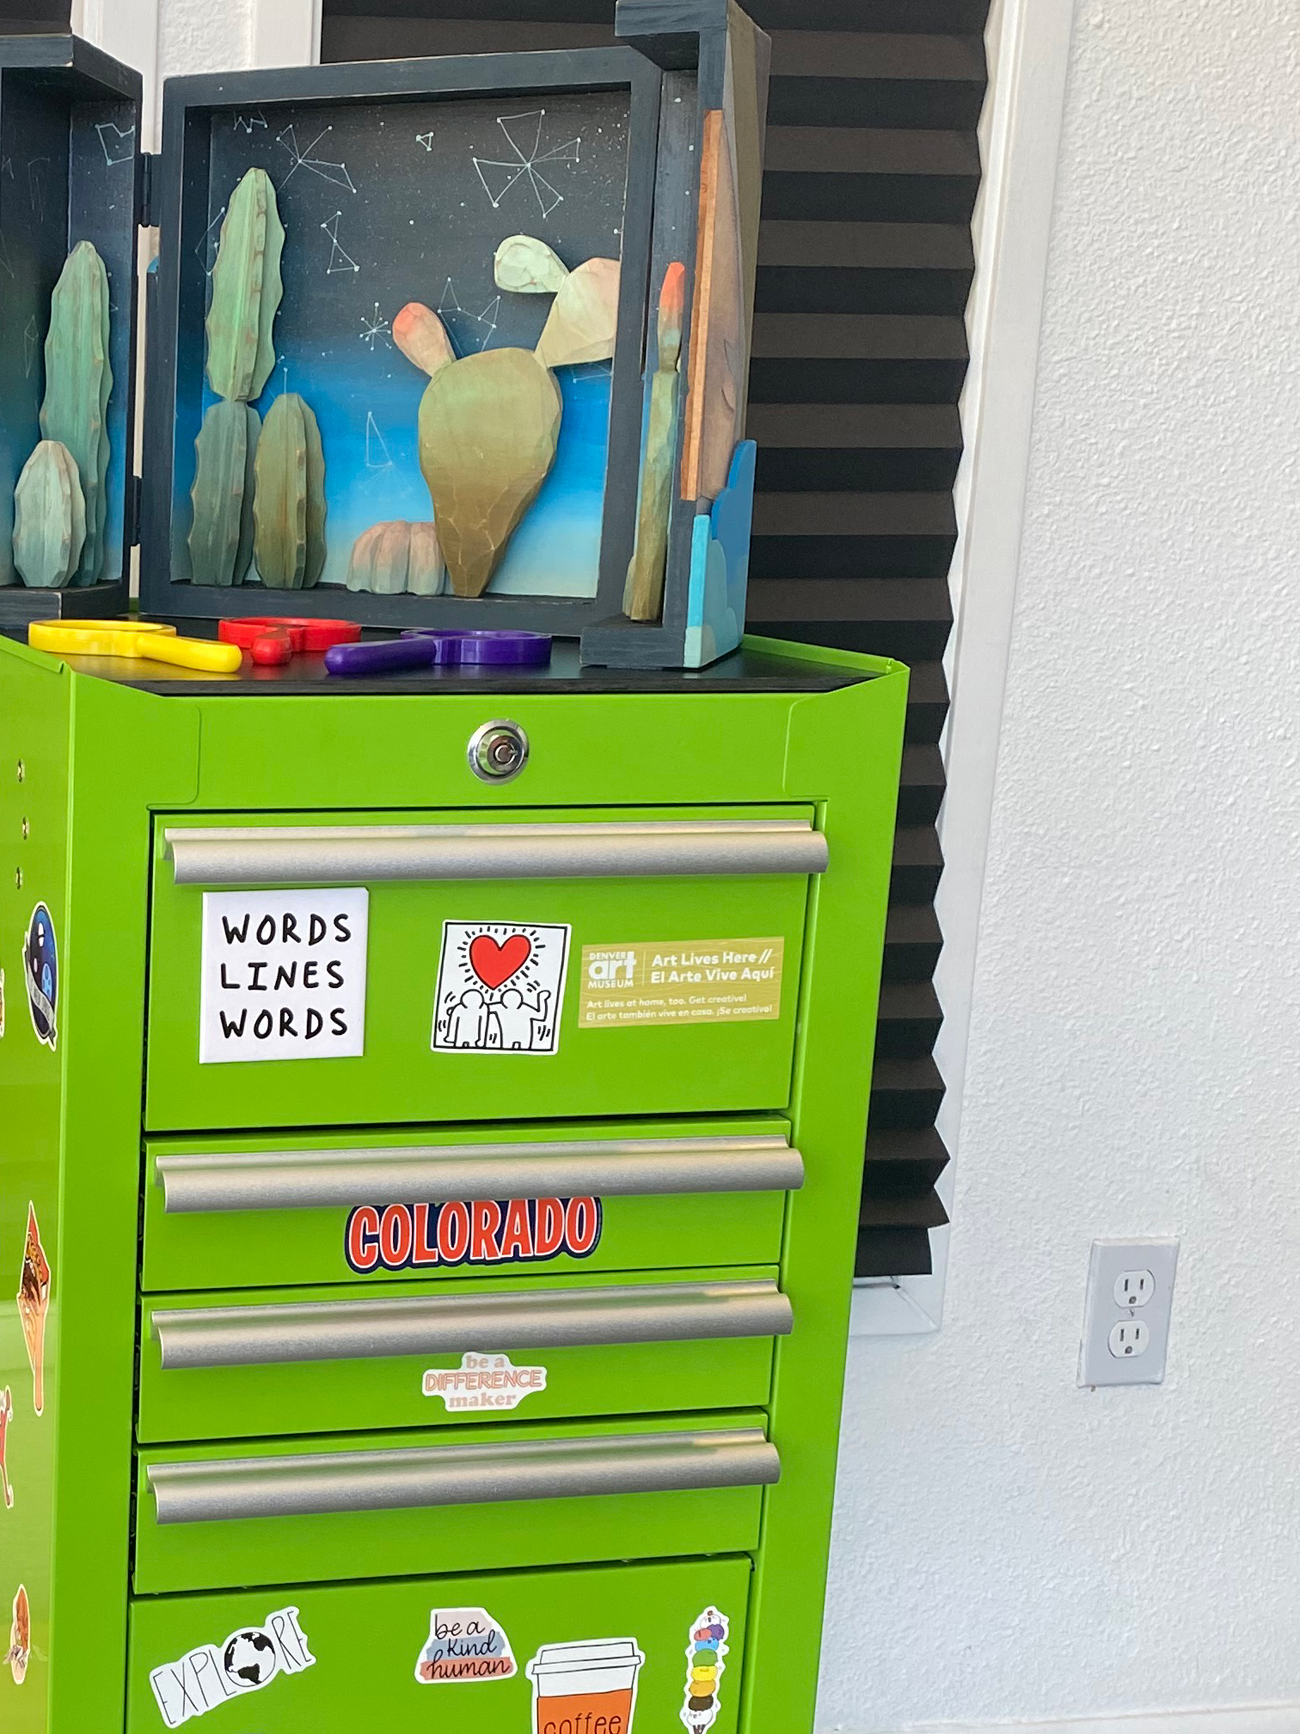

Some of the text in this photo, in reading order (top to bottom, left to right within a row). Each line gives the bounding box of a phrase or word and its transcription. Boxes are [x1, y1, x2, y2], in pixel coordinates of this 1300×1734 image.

[222, 912, 352, 946] WORDS
[588, 951, 637, 980] art
[589, 951, 628, 961] DENVER
[651, 955, 677, 967] Art
[681, 952, 719, 966] Lives
[722, 951, 757, 965] Here
[220, 960, 345, 991] LINES
[588, 979, 634, 989] MUSEUM
[651, 966, 775, 983] El Arte Vive Aquí
[586, 1000, 602, 1009] Art
[604, 999, 625, 1008] lives
[638, 998, 667, 1007] home,
[668, 996, 686, 1005] too.
[688, 995, 706, 1004] Get
[219, 1007, 348, 1041] WORDS
[586, 1012, 596, 1021] El
[597, 1012, 617, 1020] arte
[618, 1009, 657, 1019] también
[658, 1009, 677, 1018] vive
[348, 1196, 598, 1269] COLORADO
[465, 1355, 505, 1369] be a
[424, 1369, 543, 1392] DIFFERENCE
[449, 1392, 517, 1408] maker
[434, 1613, 485, 1640] be a
[426, 1649, 511, 1679] human
[543, 1711, 622, 1734] coffee
